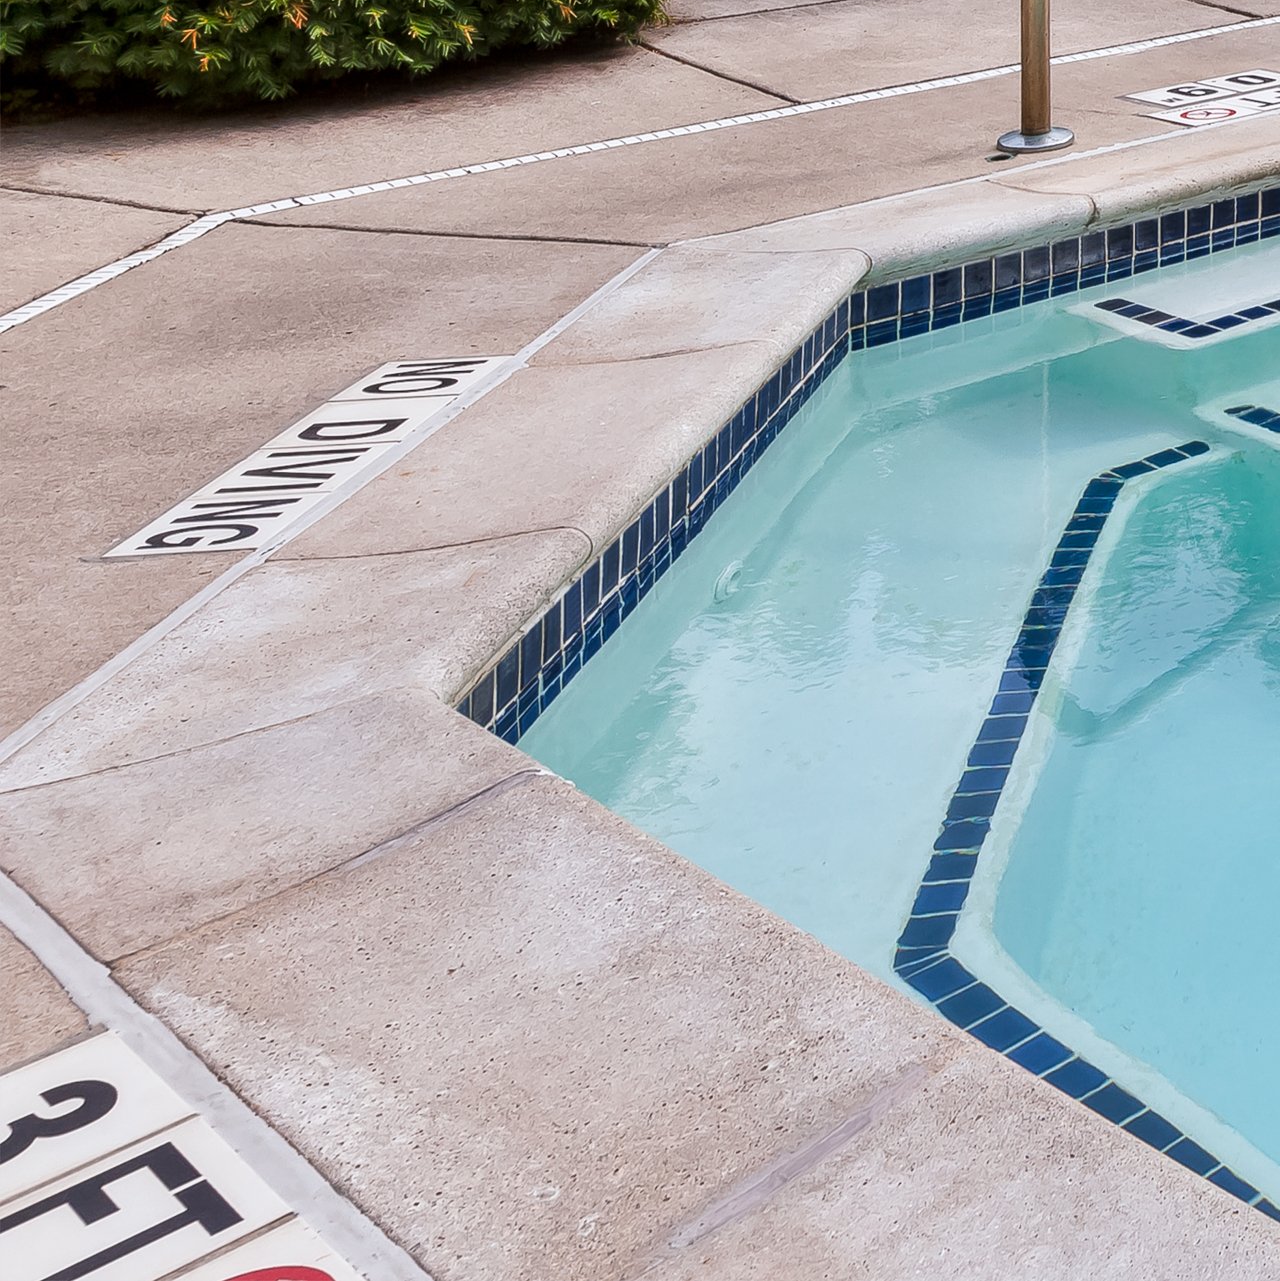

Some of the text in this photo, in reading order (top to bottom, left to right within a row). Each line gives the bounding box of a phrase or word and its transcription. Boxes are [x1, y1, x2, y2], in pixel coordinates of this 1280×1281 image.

[135, 359, 489, 550] NO DIVING
[0, 1079, 245, 1281] 3 FT
